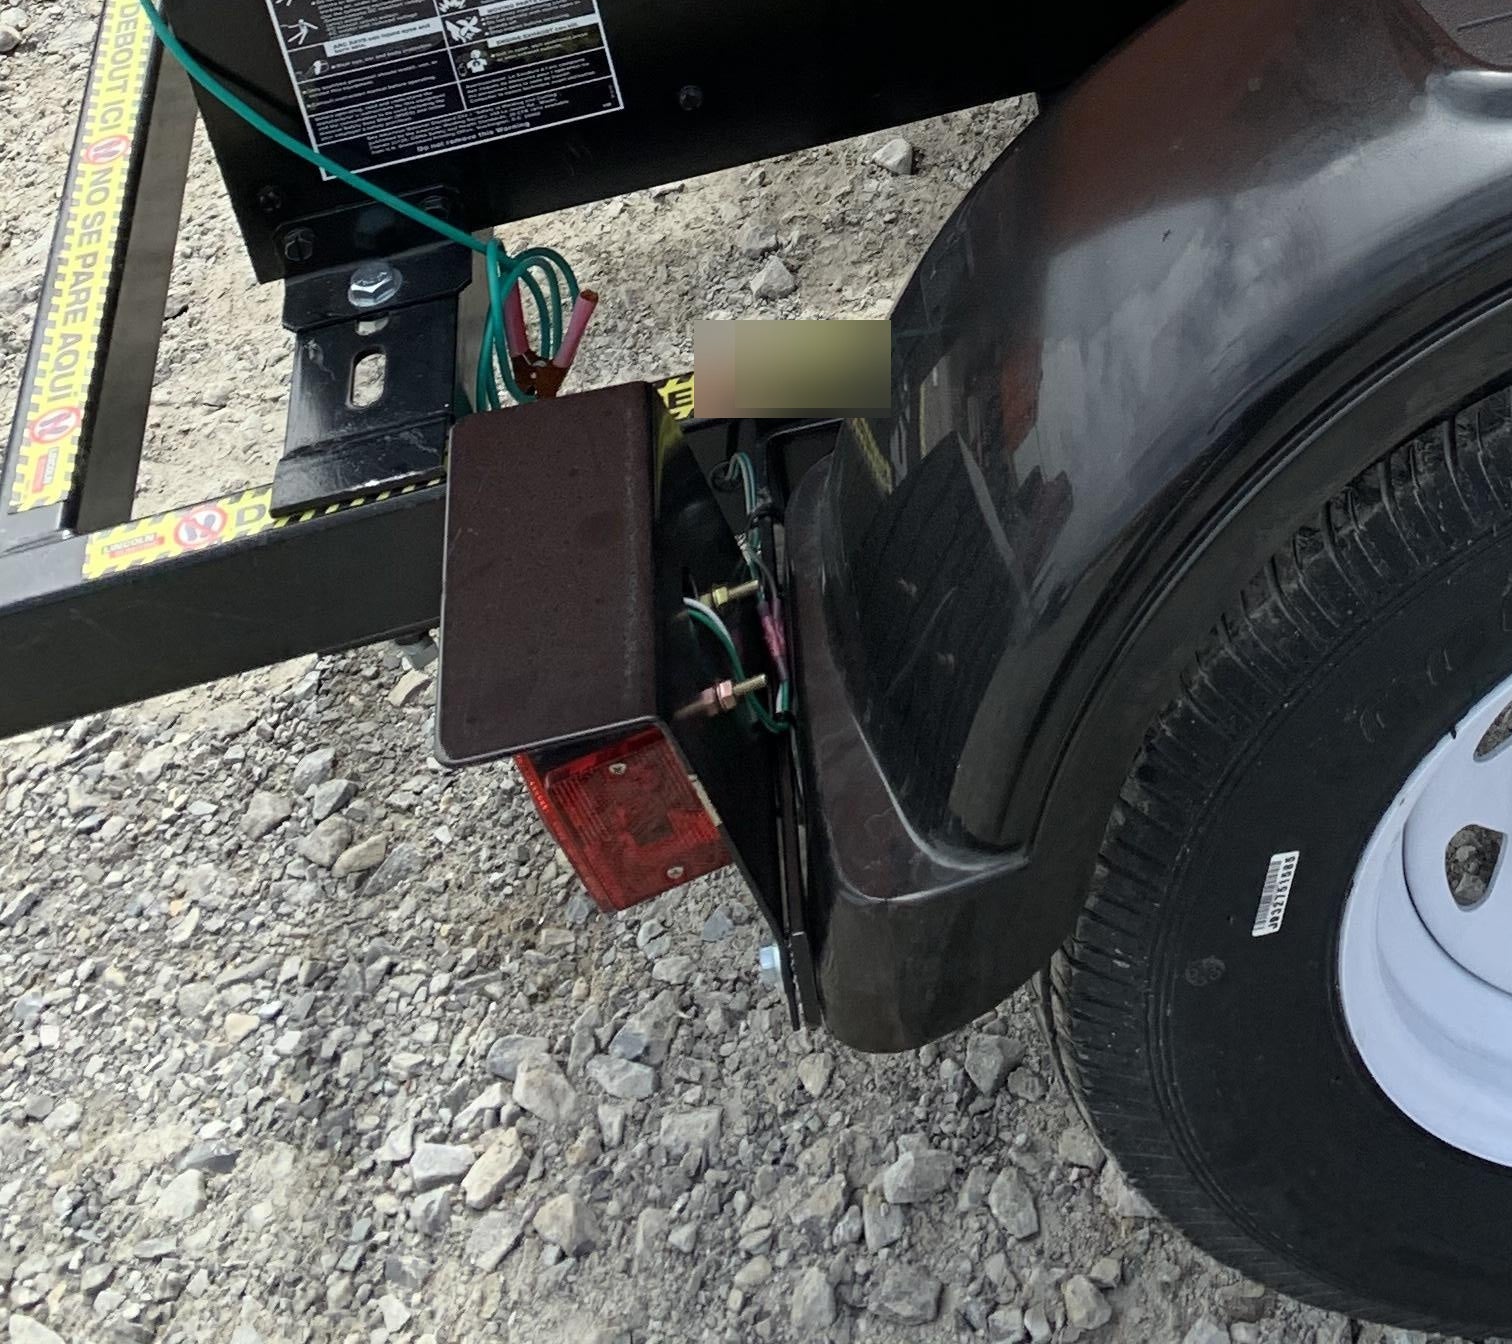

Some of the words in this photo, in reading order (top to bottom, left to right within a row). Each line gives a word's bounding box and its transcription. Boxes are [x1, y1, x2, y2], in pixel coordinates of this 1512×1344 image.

[107, 0, 140, 95] DEBOUT
[98, 97, 124, 132] ICI
[85, 167, 114, 207] NO
[76, 210, 106, 248] SE
[61, 249, 100, 327] PARE
